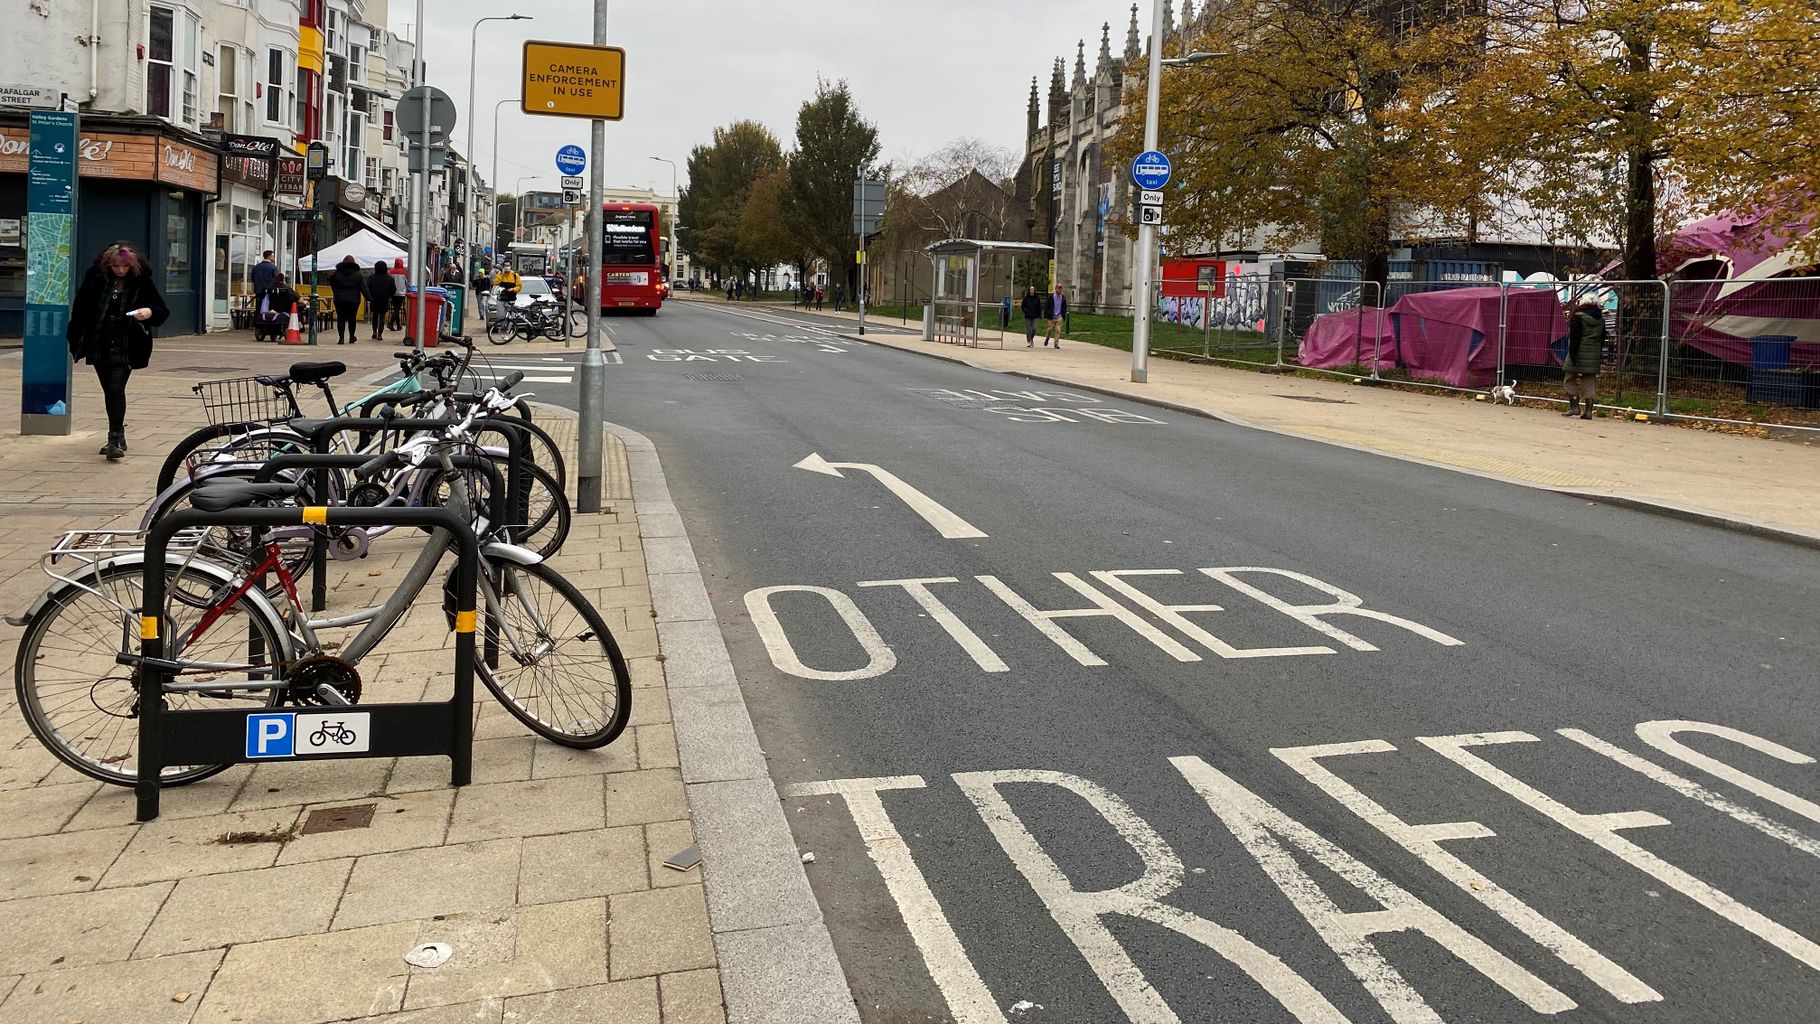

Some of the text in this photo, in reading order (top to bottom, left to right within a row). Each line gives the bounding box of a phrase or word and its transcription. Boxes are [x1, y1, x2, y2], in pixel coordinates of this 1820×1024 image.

[550, 64, 598, 75] CAMERA
[530, 74, 617, 88] ENFORCEMENT
[0, 88, 40, 96] RAFALGAR
[554, 87, 592, 97] IN USE
[79, 139, 112, 160] lé!
[1143, 193, 1161, 203] Only
[744, 566, 1465, 681] OTHER
[258, 719, 287, 753] P
